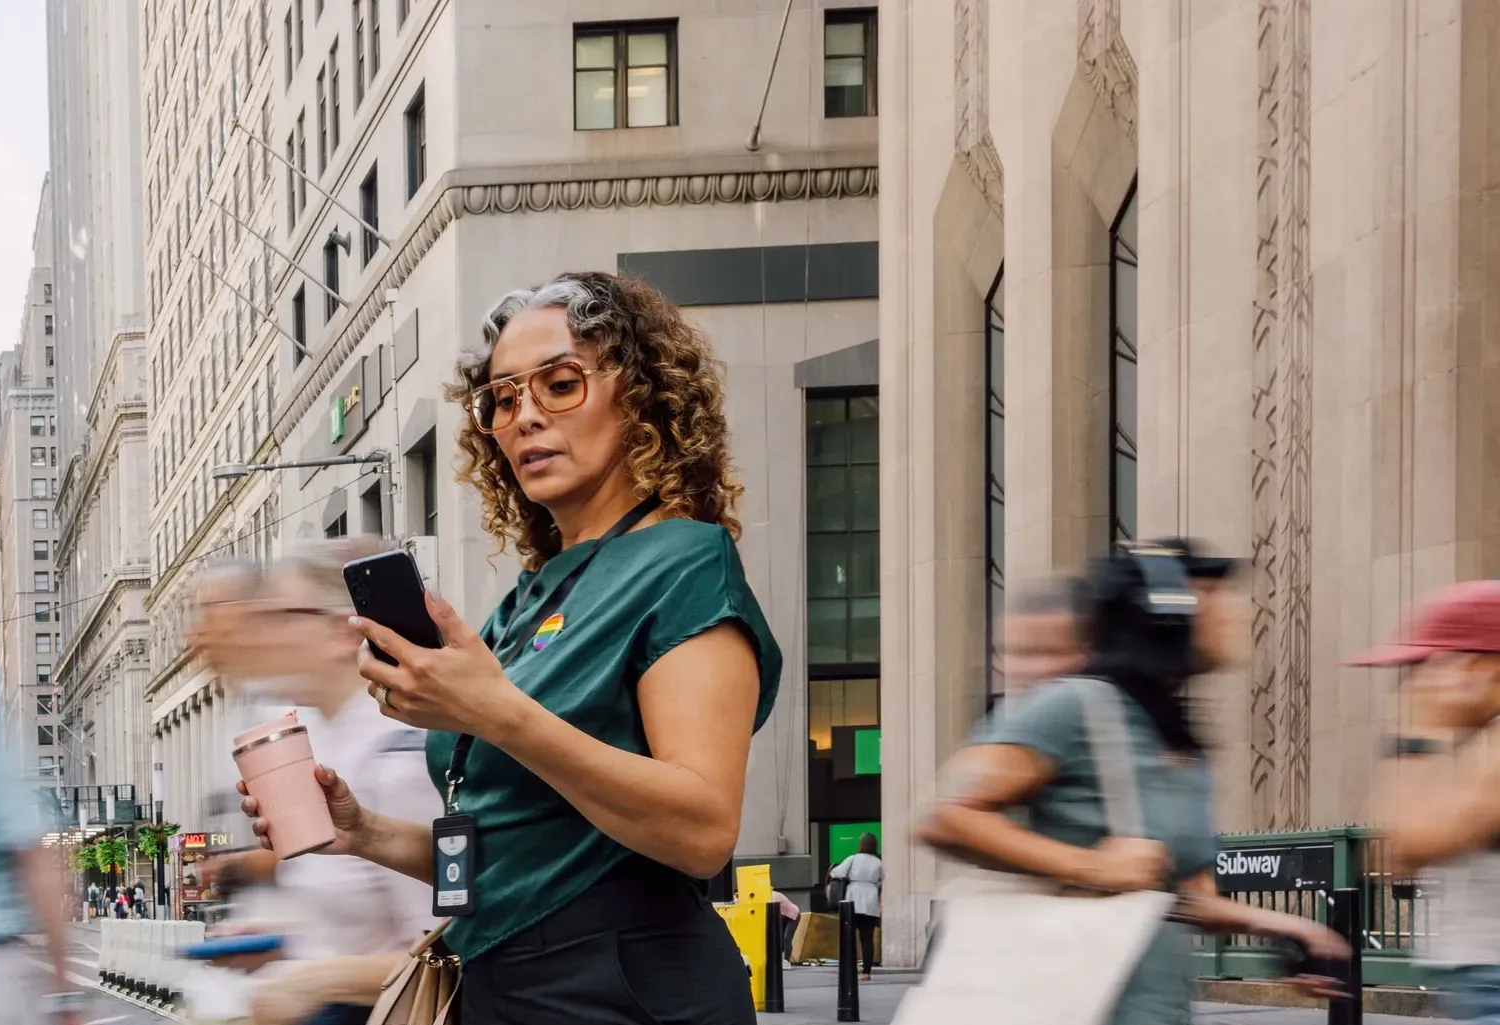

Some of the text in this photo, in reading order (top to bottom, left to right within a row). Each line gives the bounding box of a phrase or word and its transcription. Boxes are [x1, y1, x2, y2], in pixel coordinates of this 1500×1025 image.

[186, 833, 234, 845] HOT FO
[1216, 852, 1281, 878] Subway
